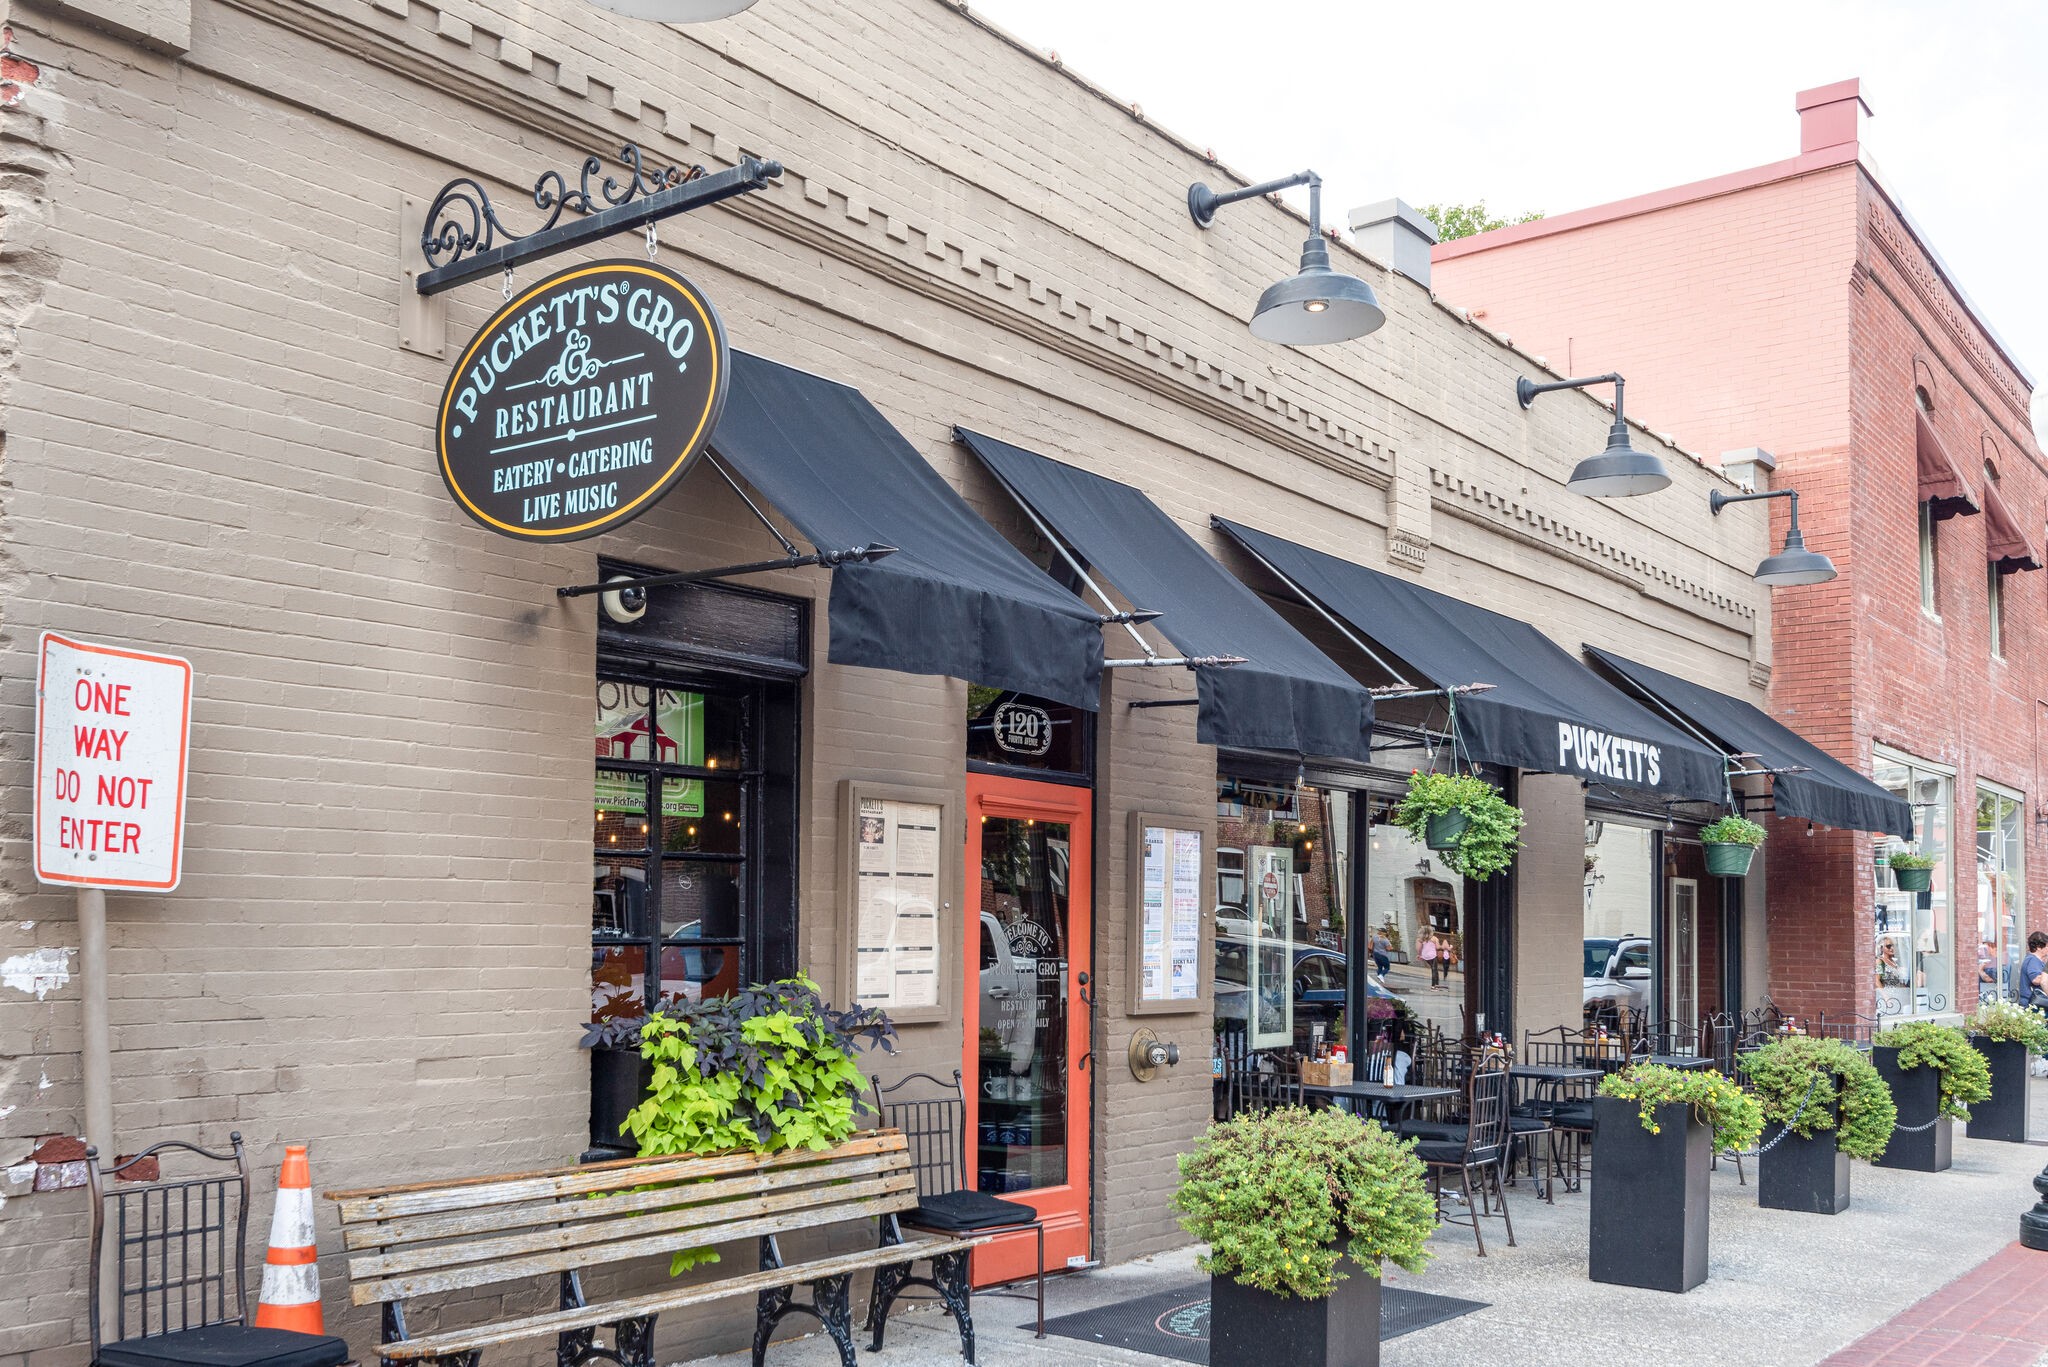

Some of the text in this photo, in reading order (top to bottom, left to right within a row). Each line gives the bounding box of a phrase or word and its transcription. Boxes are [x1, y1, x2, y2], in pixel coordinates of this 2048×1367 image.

[626, 288, 694, 374] GRO.
[495, 371, 653, 439] RESTAURANT
[493, 437, 652, 493] EATERY CATERING
[523, 482, 618, 523] LIVE MUSIC
[75, 678, 131, 716] ONE
[74, 724, 129, 761] WAY
[1008, 711, 1039, 737] 120
[1558, 721, 1660, 785] PUCKETT'S
[56, 767, 153, 810] DO NOT
[60, 816, 141, 854] ENTER
[1037, 930, 1049, 947] TO
[1038, 961, 1059, 976] GRO.
[997, 1018, 1015, 1029] OPEN
[1001, 999, 1047, 1011] RESTAURANT
